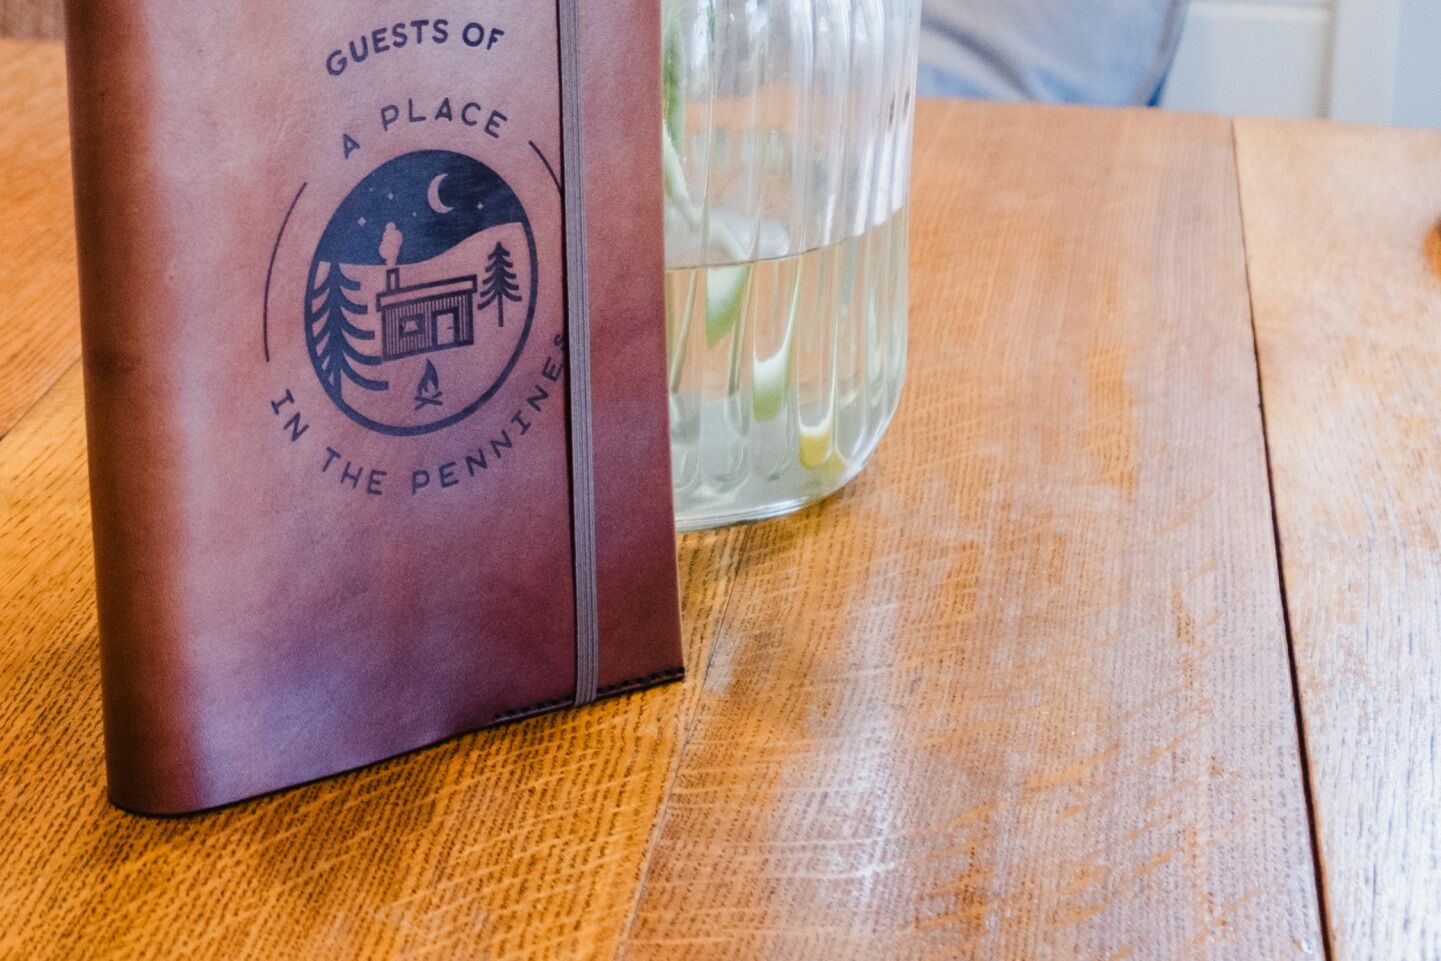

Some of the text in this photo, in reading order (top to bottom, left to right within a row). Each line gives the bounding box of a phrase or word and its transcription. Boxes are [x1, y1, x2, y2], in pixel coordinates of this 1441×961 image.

[326, 18, 505, 76] GUESTS OF
[342, 97, 508, 160] A PLACE
[271, 388, 309, 443] IN
[320, 446, 389, 497] THE
